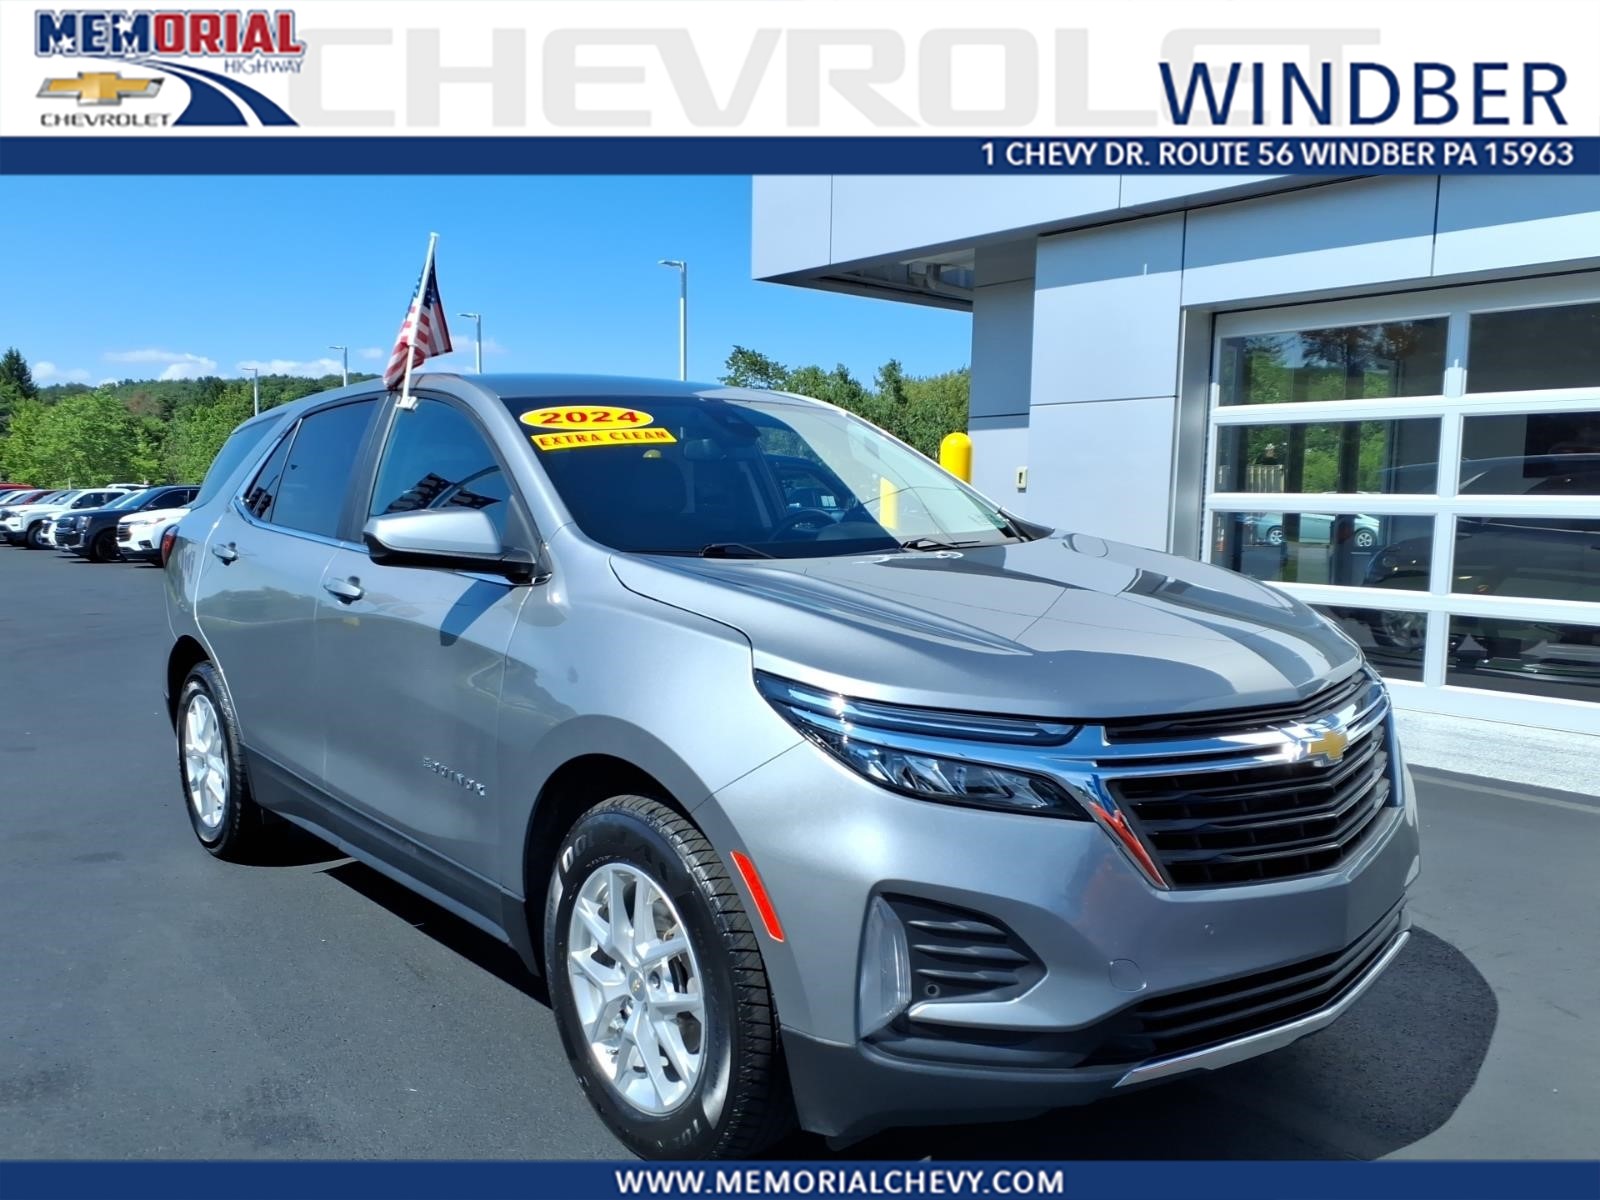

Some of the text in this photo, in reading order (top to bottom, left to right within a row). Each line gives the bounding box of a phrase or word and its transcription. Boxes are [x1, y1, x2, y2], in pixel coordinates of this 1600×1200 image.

[539, 411, 640, 424] 2024
[538, 431, 668, 446] EXTRA CLEAN
